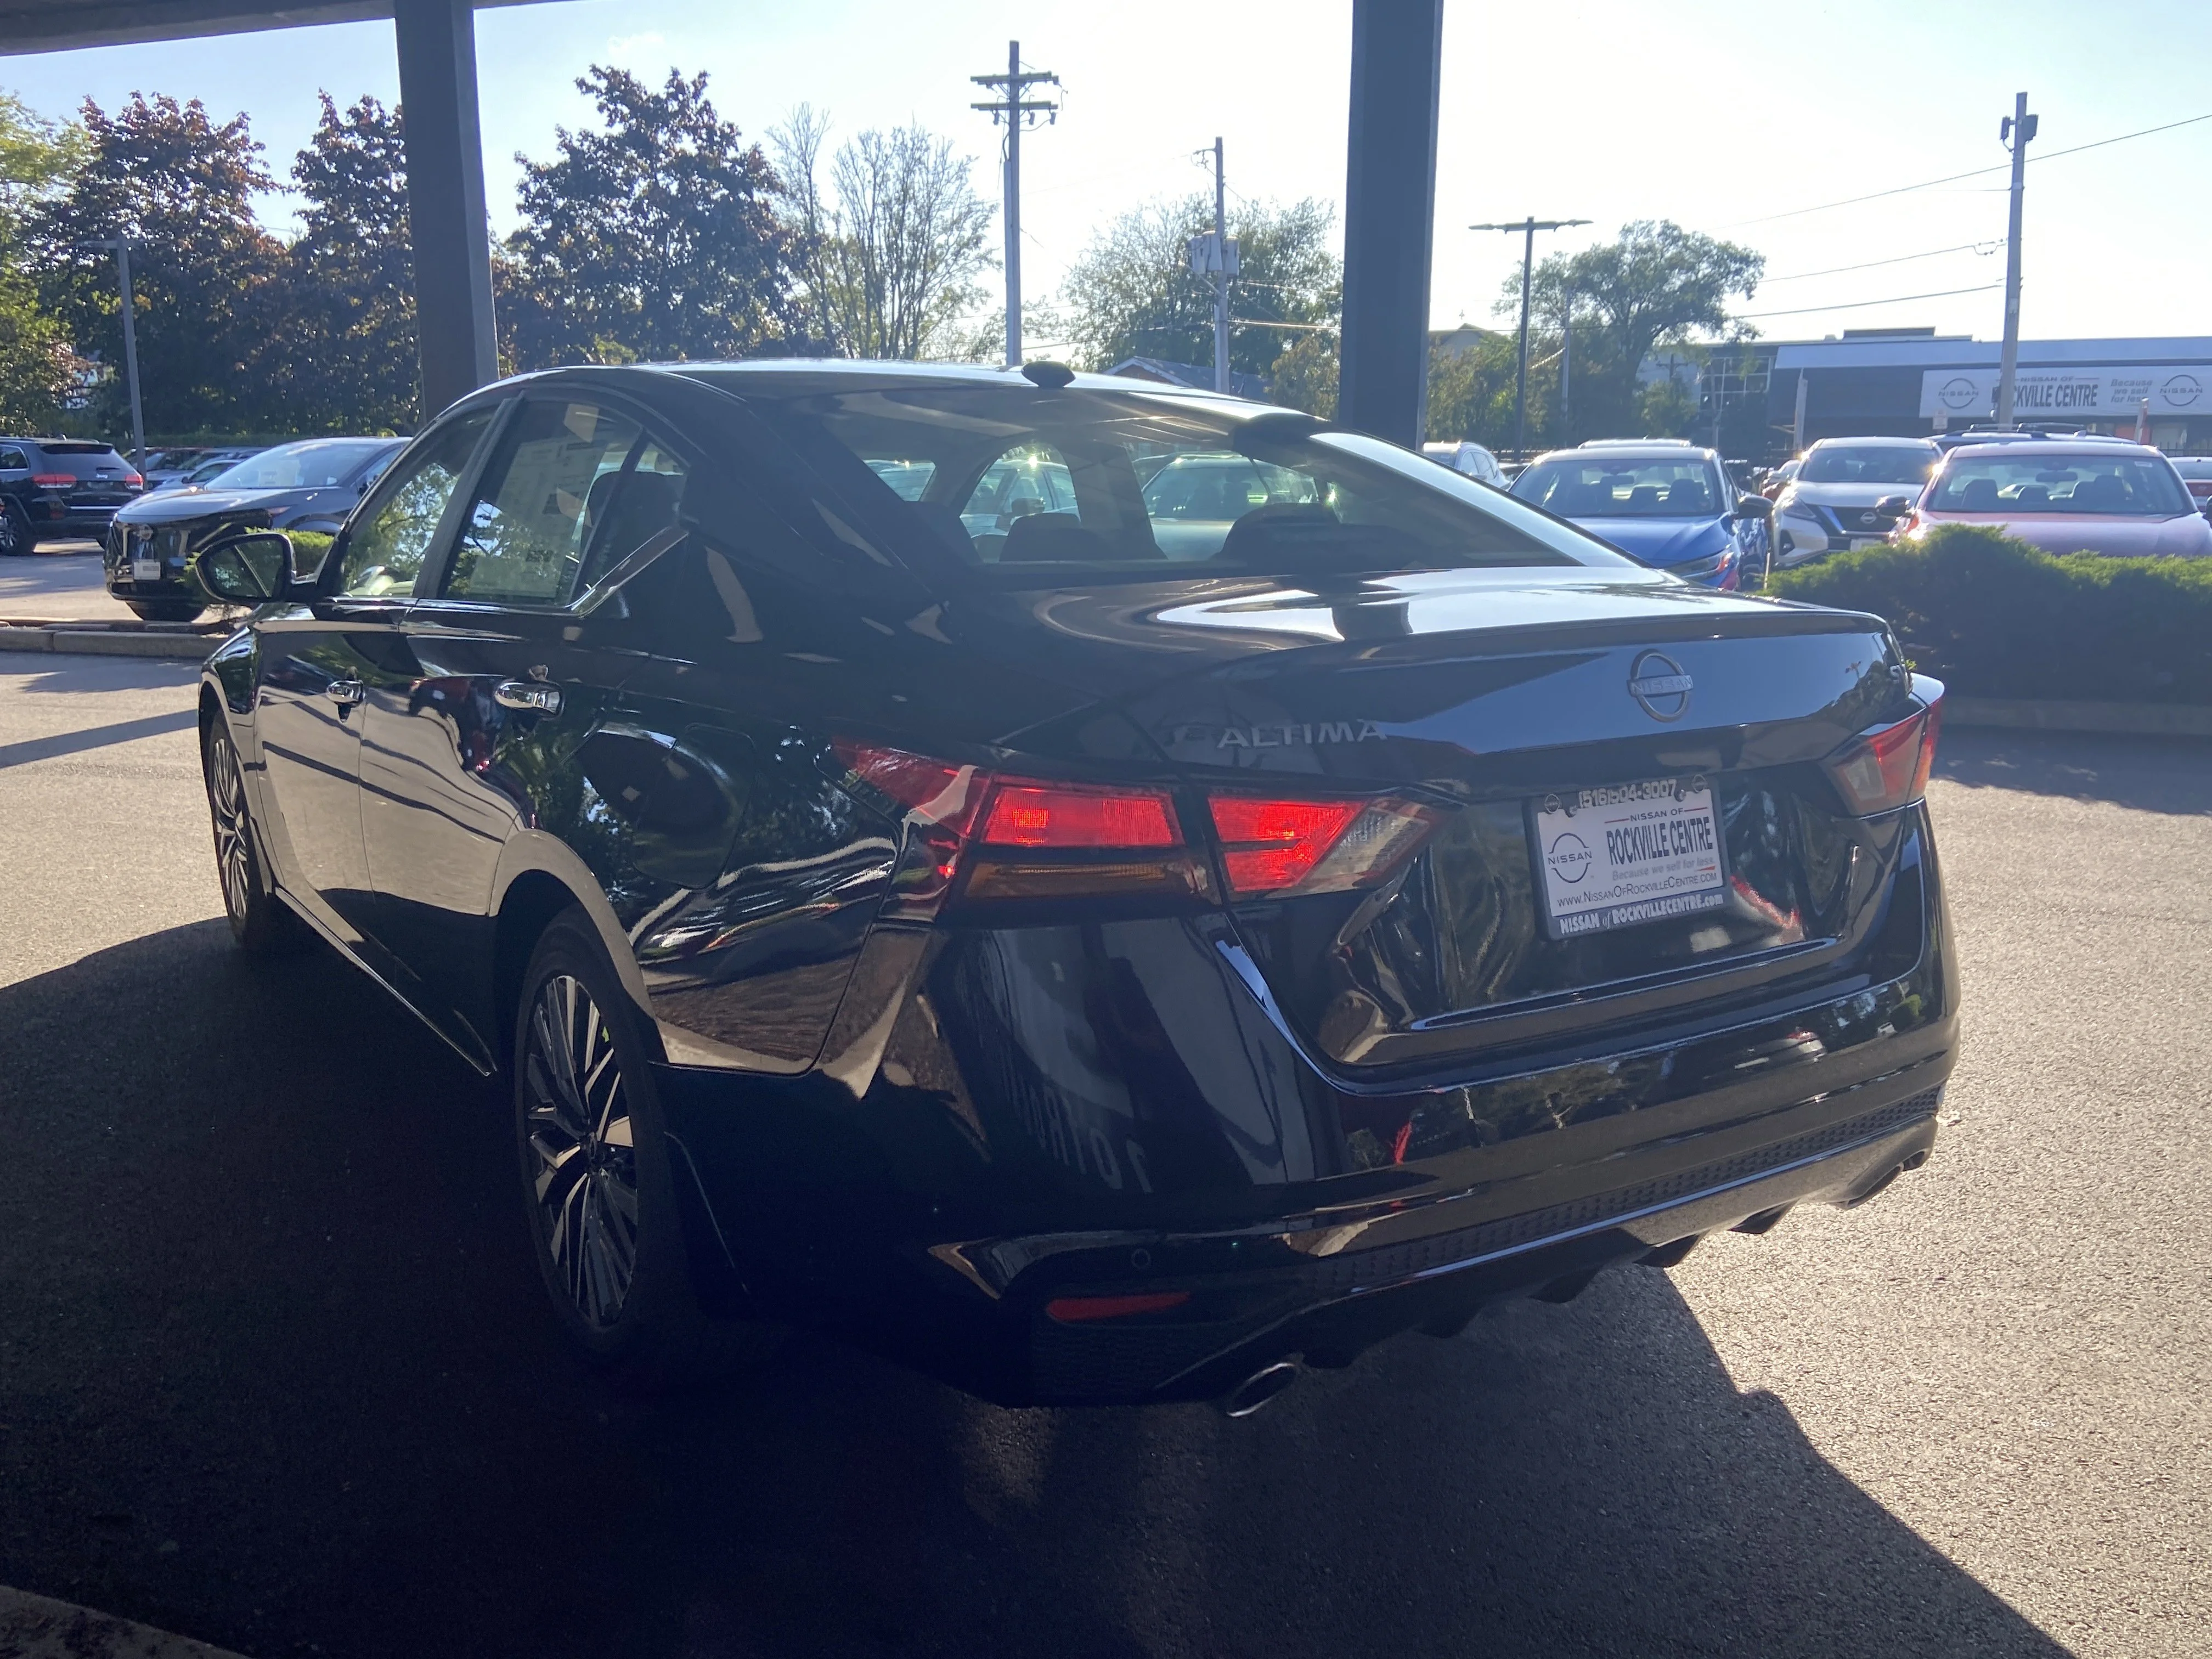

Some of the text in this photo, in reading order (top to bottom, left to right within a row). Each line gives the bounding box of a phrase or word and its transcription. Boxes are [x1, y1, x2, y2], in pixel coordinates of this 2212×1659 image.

[2111, 379, 2153, 387] Because
[2130, 386, 2149, 394] sell
[2055, 384, 2098, 407] CENTRE
[2111, 394, 2141, 403] for les
[1216, 719, 1388, 749] ALTIMA
[1630, 808, 1684, 822] NISSAN OF
[1606, 816, 1713, 865] ROCKVILLE CENTRE
[1548, 851, 1592, 865] NISSAN
[1612, 867, 1649, 881] Because
[1652, 865, 1664, 873] we
[1666, 861, 1681, 871] sell
[1683, 859, 1695, 869] for
[1560, 894, 1724, 935] NISSAN of ROCKVILLECENTRE.com
